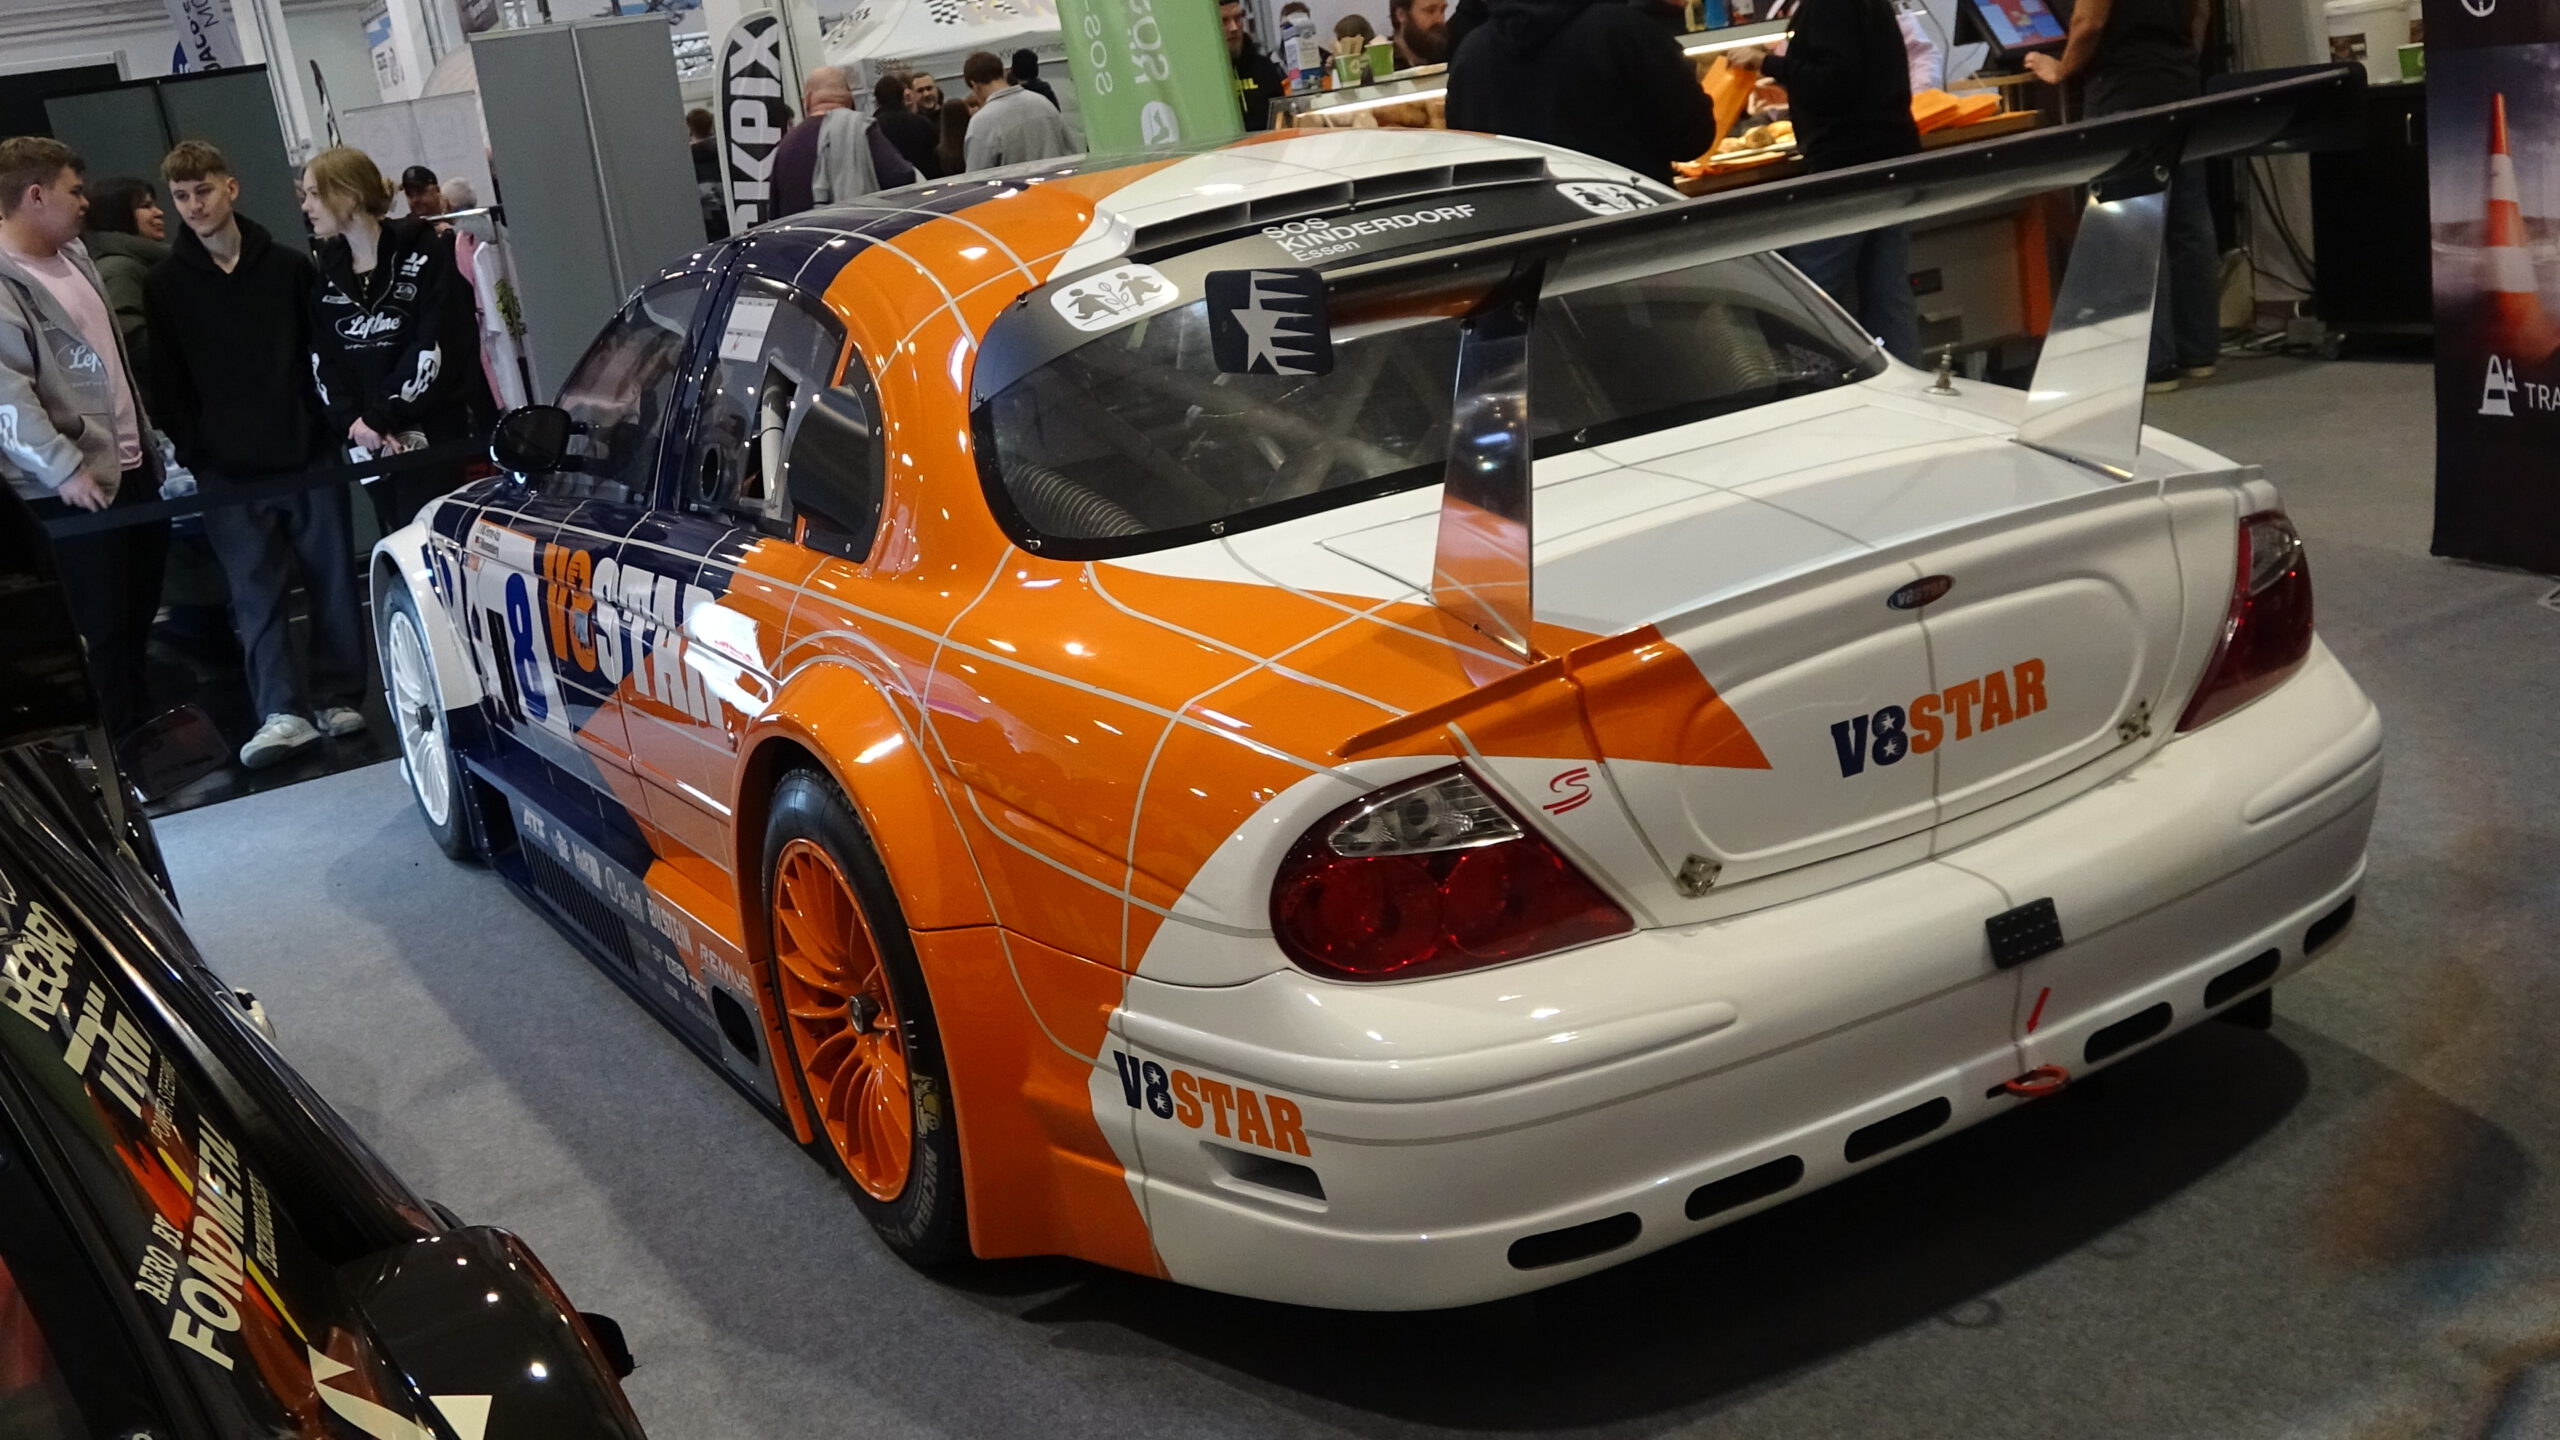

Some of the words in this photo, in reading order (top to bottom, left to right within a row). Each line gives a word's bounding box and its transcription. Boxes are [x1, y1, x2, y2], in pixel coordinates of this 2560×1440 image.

[1261, 217, 1330, 239] SOS
[1276, 204, 1476, 252] KINDERDORF
[1291, 241, 1360, 262] Essen
[1830, 657, 2048, 778] V8STAR
[0, 900, 78, 1031] RECARO
[700, 943, 754, 998] REMUS
[151, 1098, 175, 1147] POWER
[1113, 1050, 1312, 1157] V8STAR
[152, 1212, 185, 1251] BY
[168, 1114, 244, 1371] FONDMETAL
[134, 1244, 179, 1306] AERO
